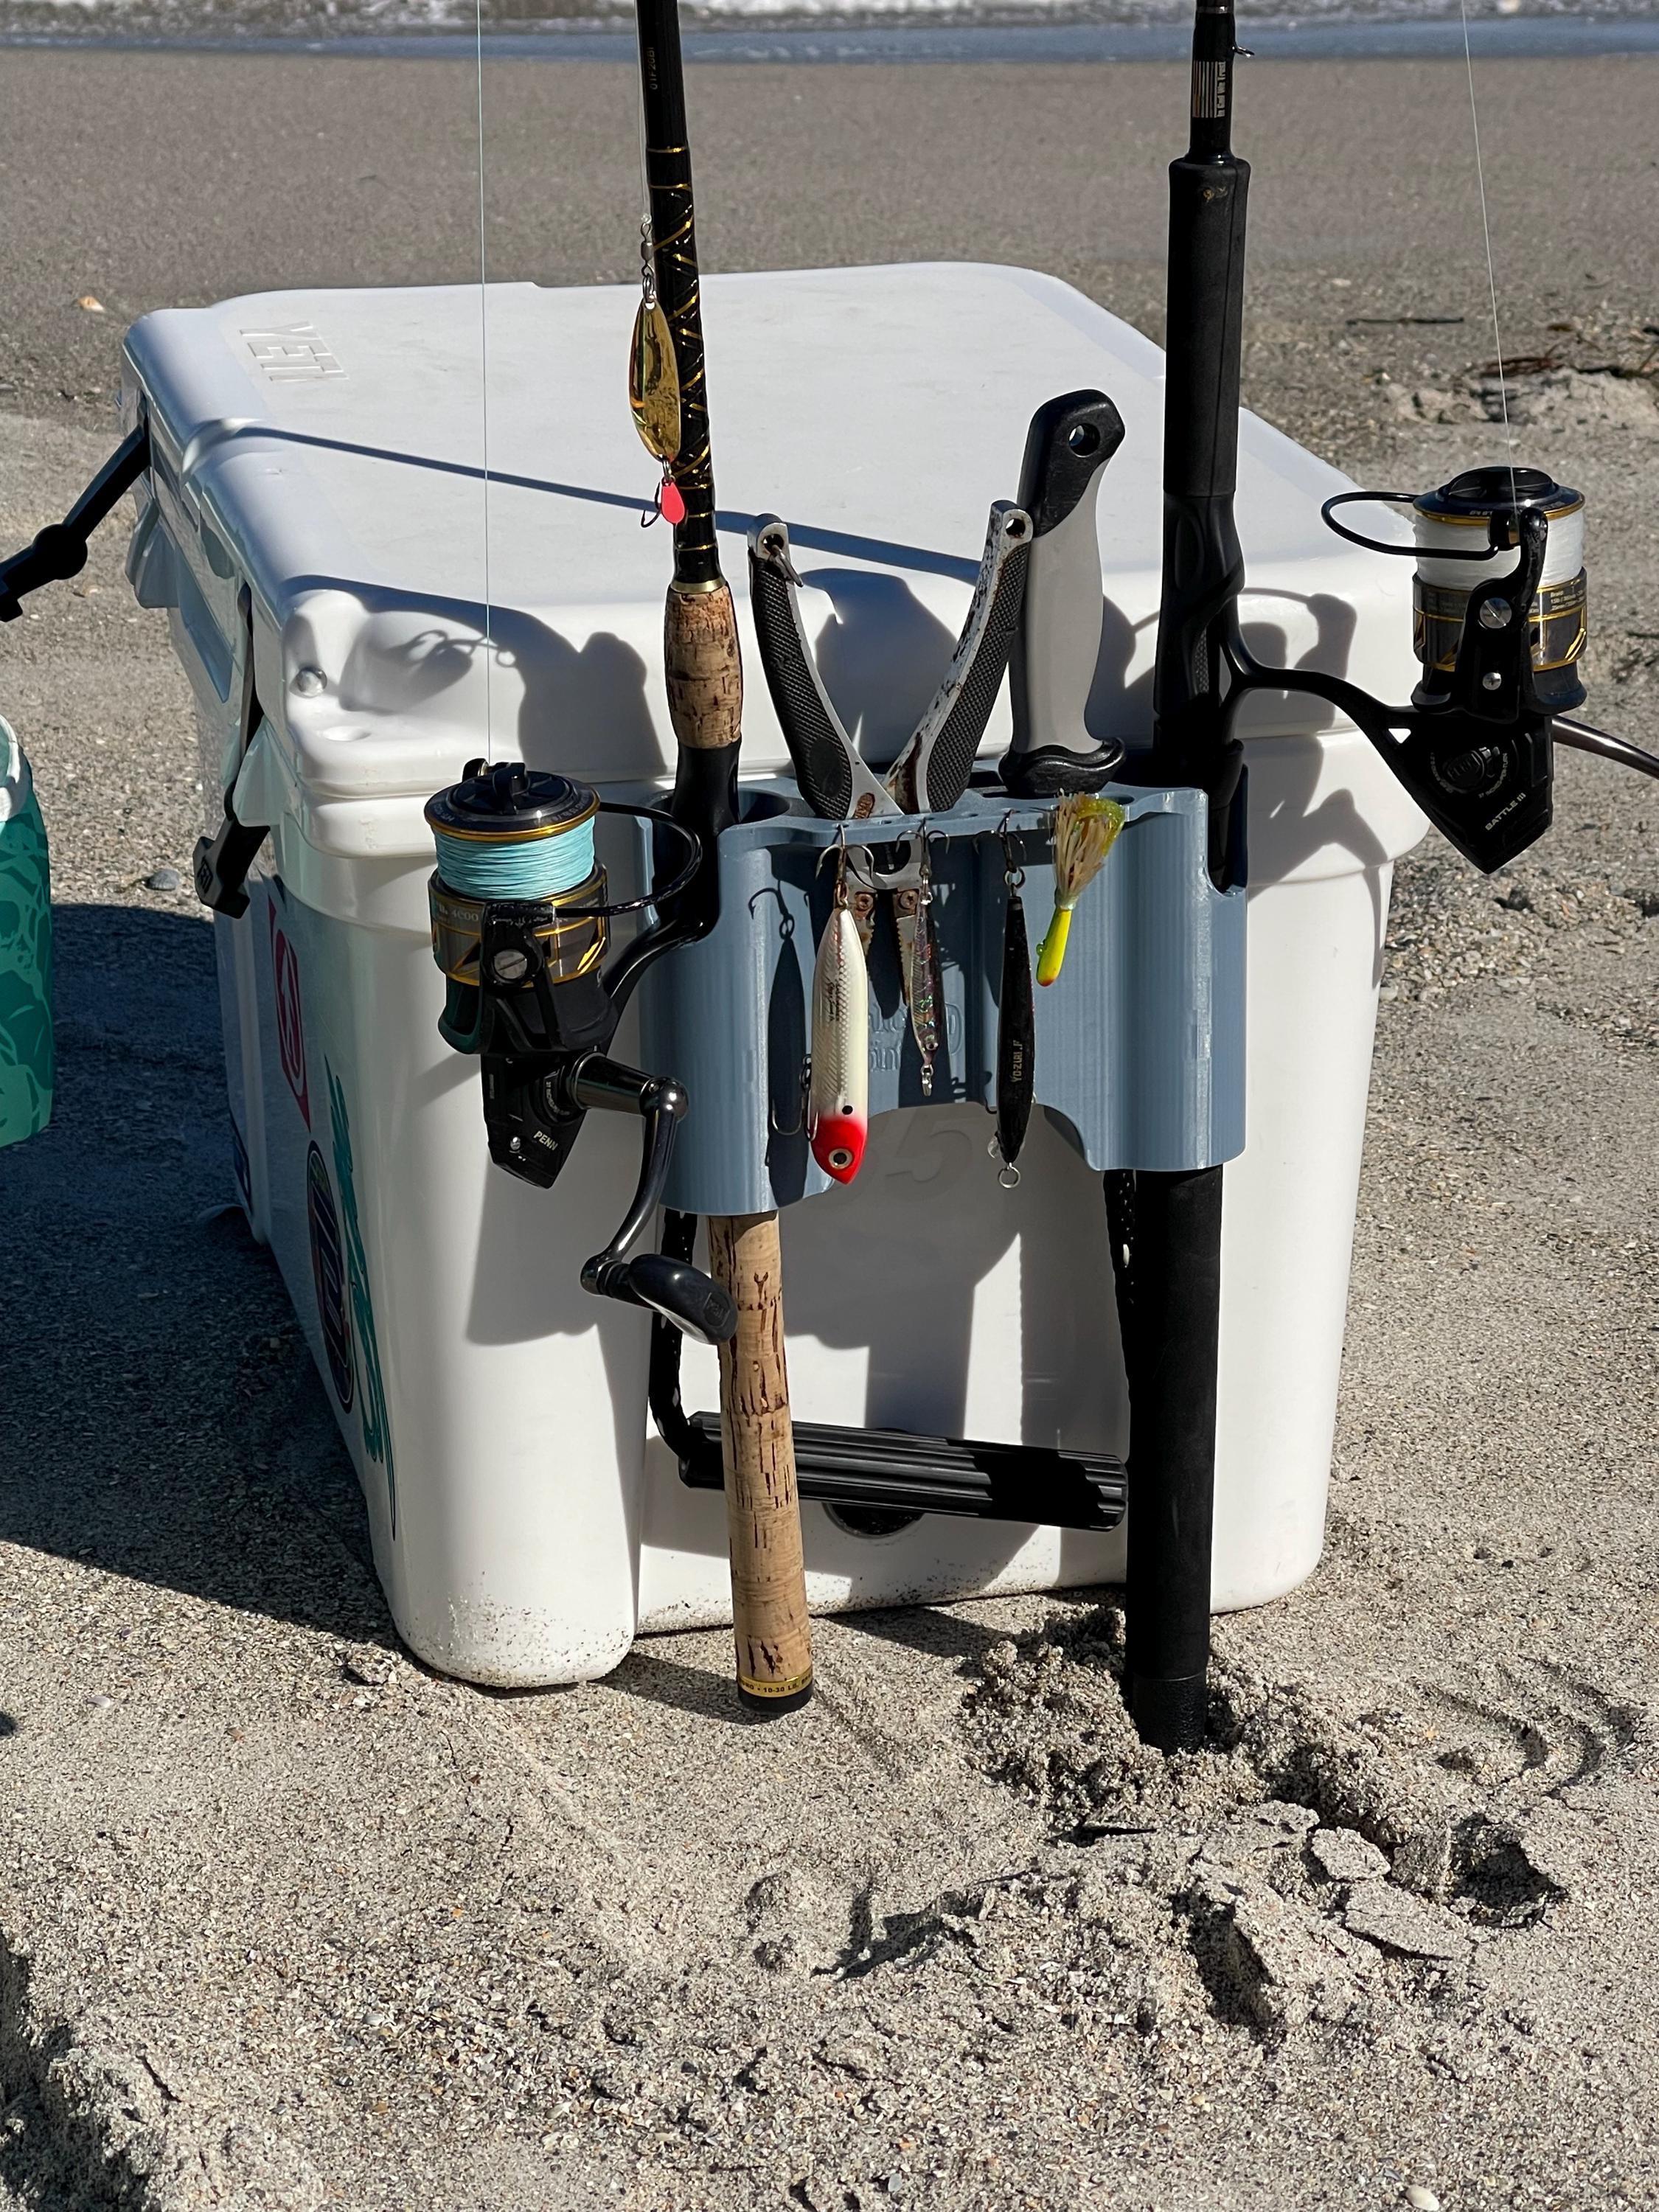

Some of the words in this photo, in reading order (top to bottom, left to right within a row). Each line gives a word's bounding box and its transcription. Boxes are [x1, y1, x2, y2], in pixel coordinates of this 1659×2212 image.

[240, 321, 349, 381] YETI
[1485, 800, 1519, 831] BATTLE
[533, 1130, 558, 1151] PENN
